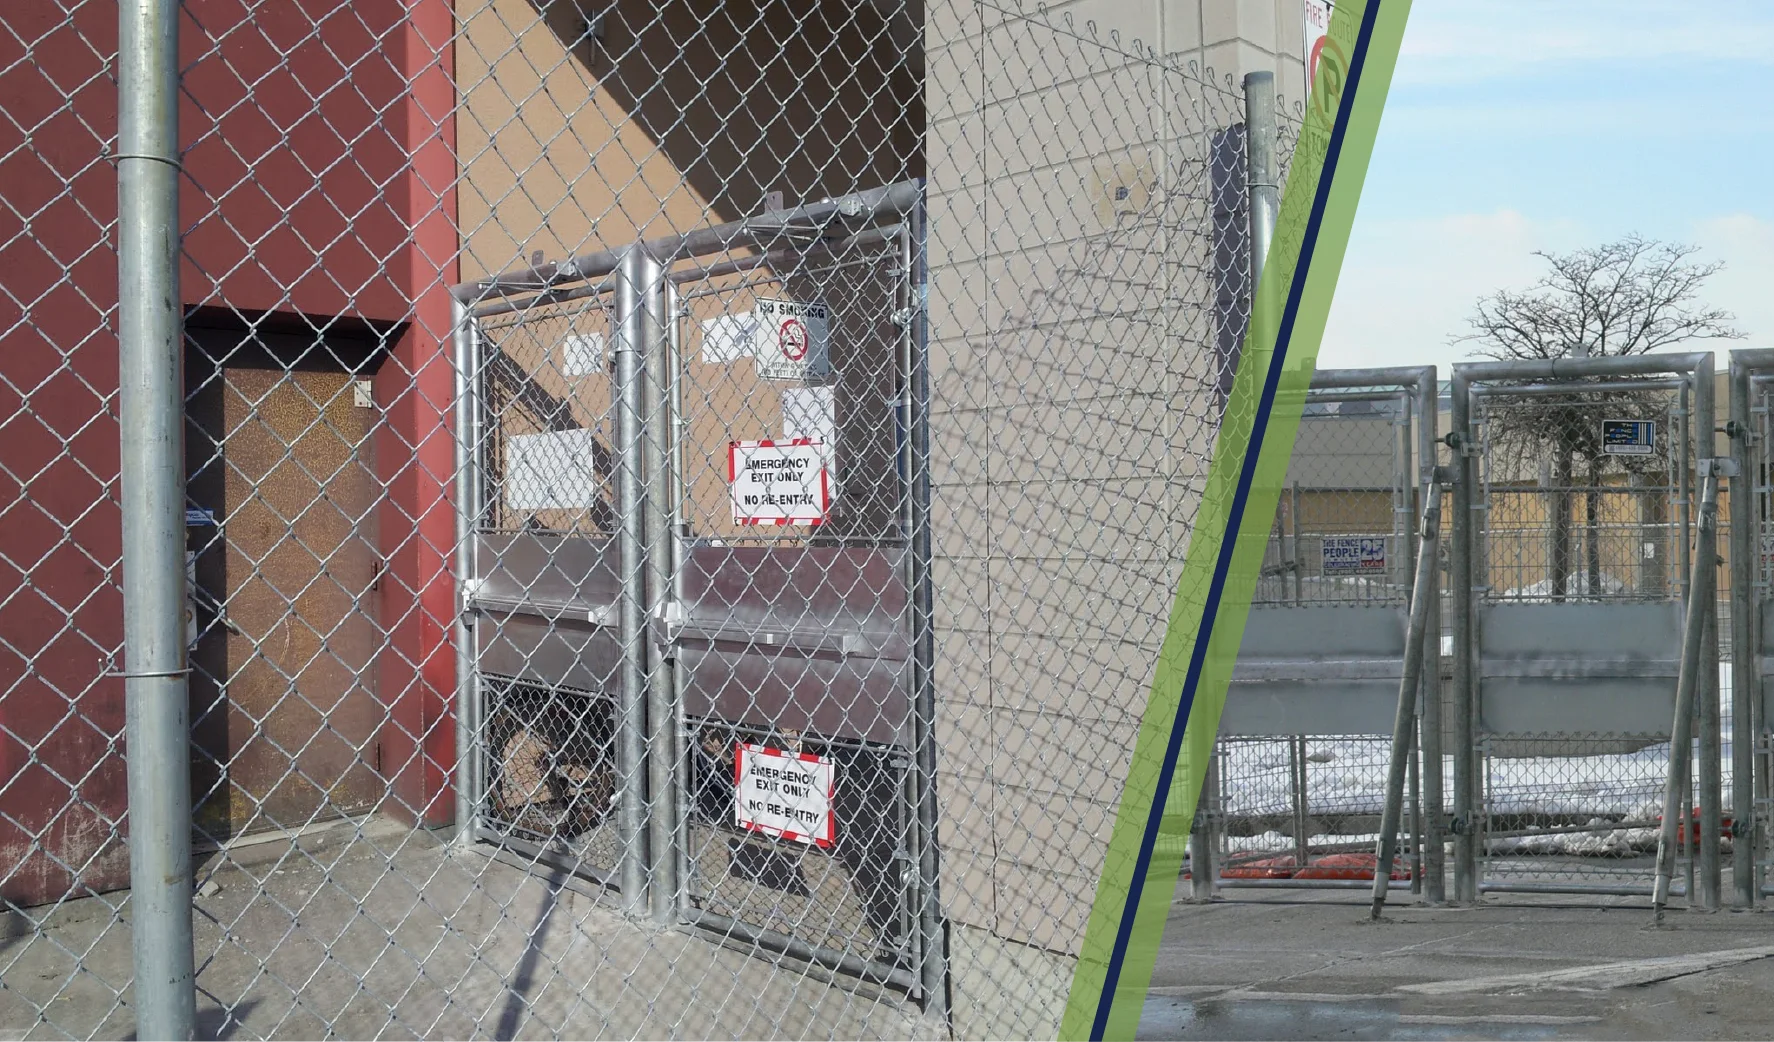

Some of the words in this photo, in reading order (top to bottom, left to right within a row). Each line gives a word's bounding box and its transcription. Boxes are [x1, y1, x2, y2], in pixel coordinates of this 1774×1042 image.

[760, 302, 775, 314] NO
[779, 303, 825, 320] SMOKING
[745, 458, 810, 470] EMERGENCY
[751, 472, 774, 482] EXIT
[777, 471, 804, 482] ONLY
[744, 494, 759, 505] NO
[761, 494, 814, 506] RE-ENTRY
[1323, 539, 1336, 548] THE
[1337, 538, 1359, 547] FENCE
[1361, 539, 1385, 561] 25
[1323, 547, 1359, 558] PEOPLE
[750, 765, 817, 785] EMERGENCY
[755, 778, 780, 792] EXIT
[782, 783, 810, 799] ONLY
[749, 798, 764, 811] NO
[766, 803, 820, 824] RE-ENTRY
